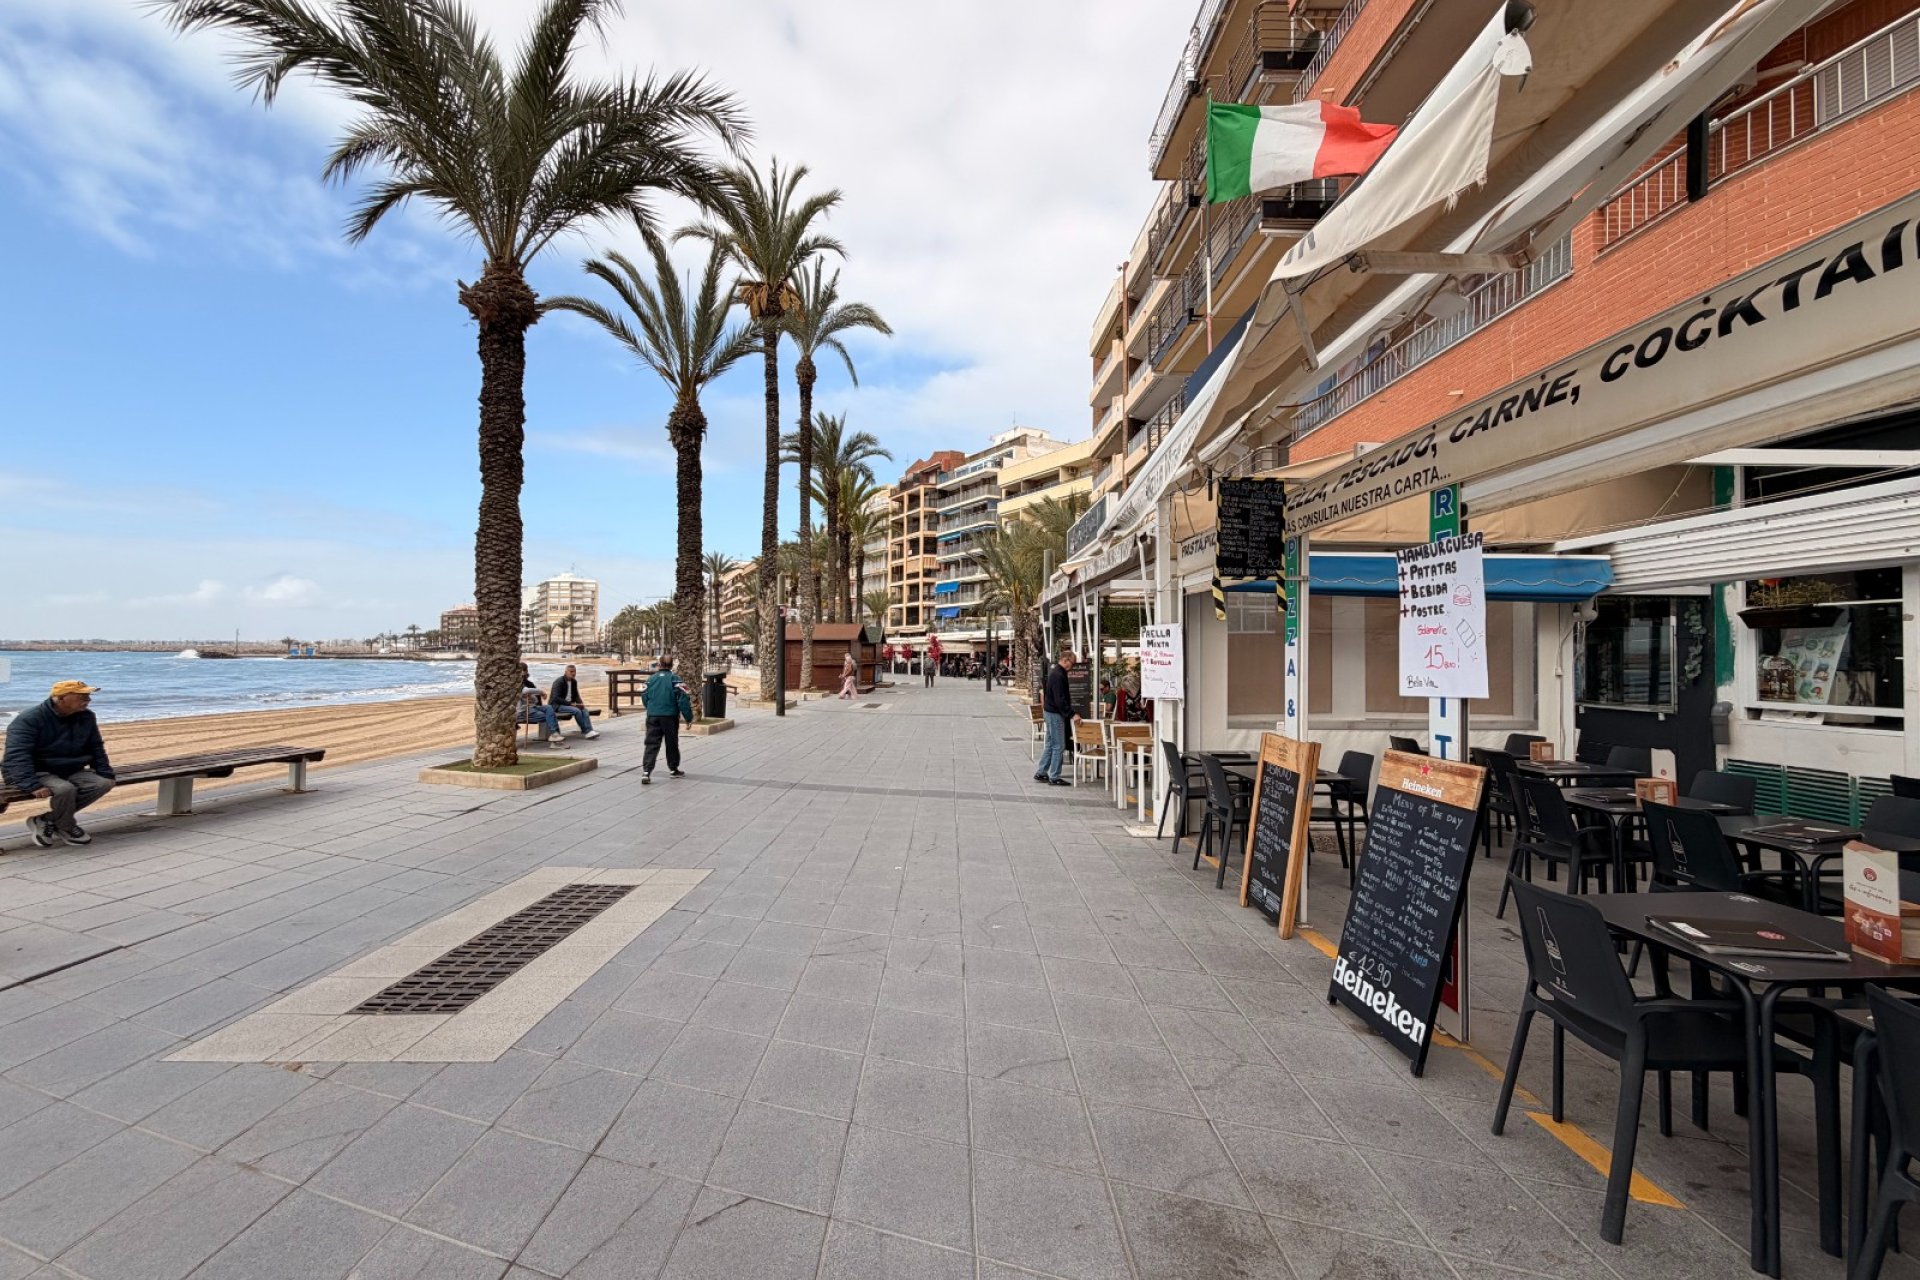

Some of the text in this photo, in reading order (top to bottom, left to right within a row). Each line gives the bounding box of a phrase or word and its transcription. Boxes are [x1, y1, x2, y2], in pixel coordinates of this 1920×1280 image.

[1332, 432, 1437, 494] PESCADO,
[1450, 369, 1580, 443] CARNE,
[1600, 218, 1920, 382] COCKTAI
[1298, 504, 1339, 529] CONSULTA
[1341, 483, 1391, 515] NUESTRA
[1396, 531, 1483, 564] HAMBURGUESA
[1410, 561, 1457, 580] PATATAS
[1286, 539, 1297, 677] PIZZA
[1411, 604, 1445, 618] POSTRE
[1141, 628, 1171, 638] PAELLA
[1402, 777, 1442, 798] Heineken
[1445, 813, 1463, 831] DAY
[1333, 955, 1427, 1047] Heineken
